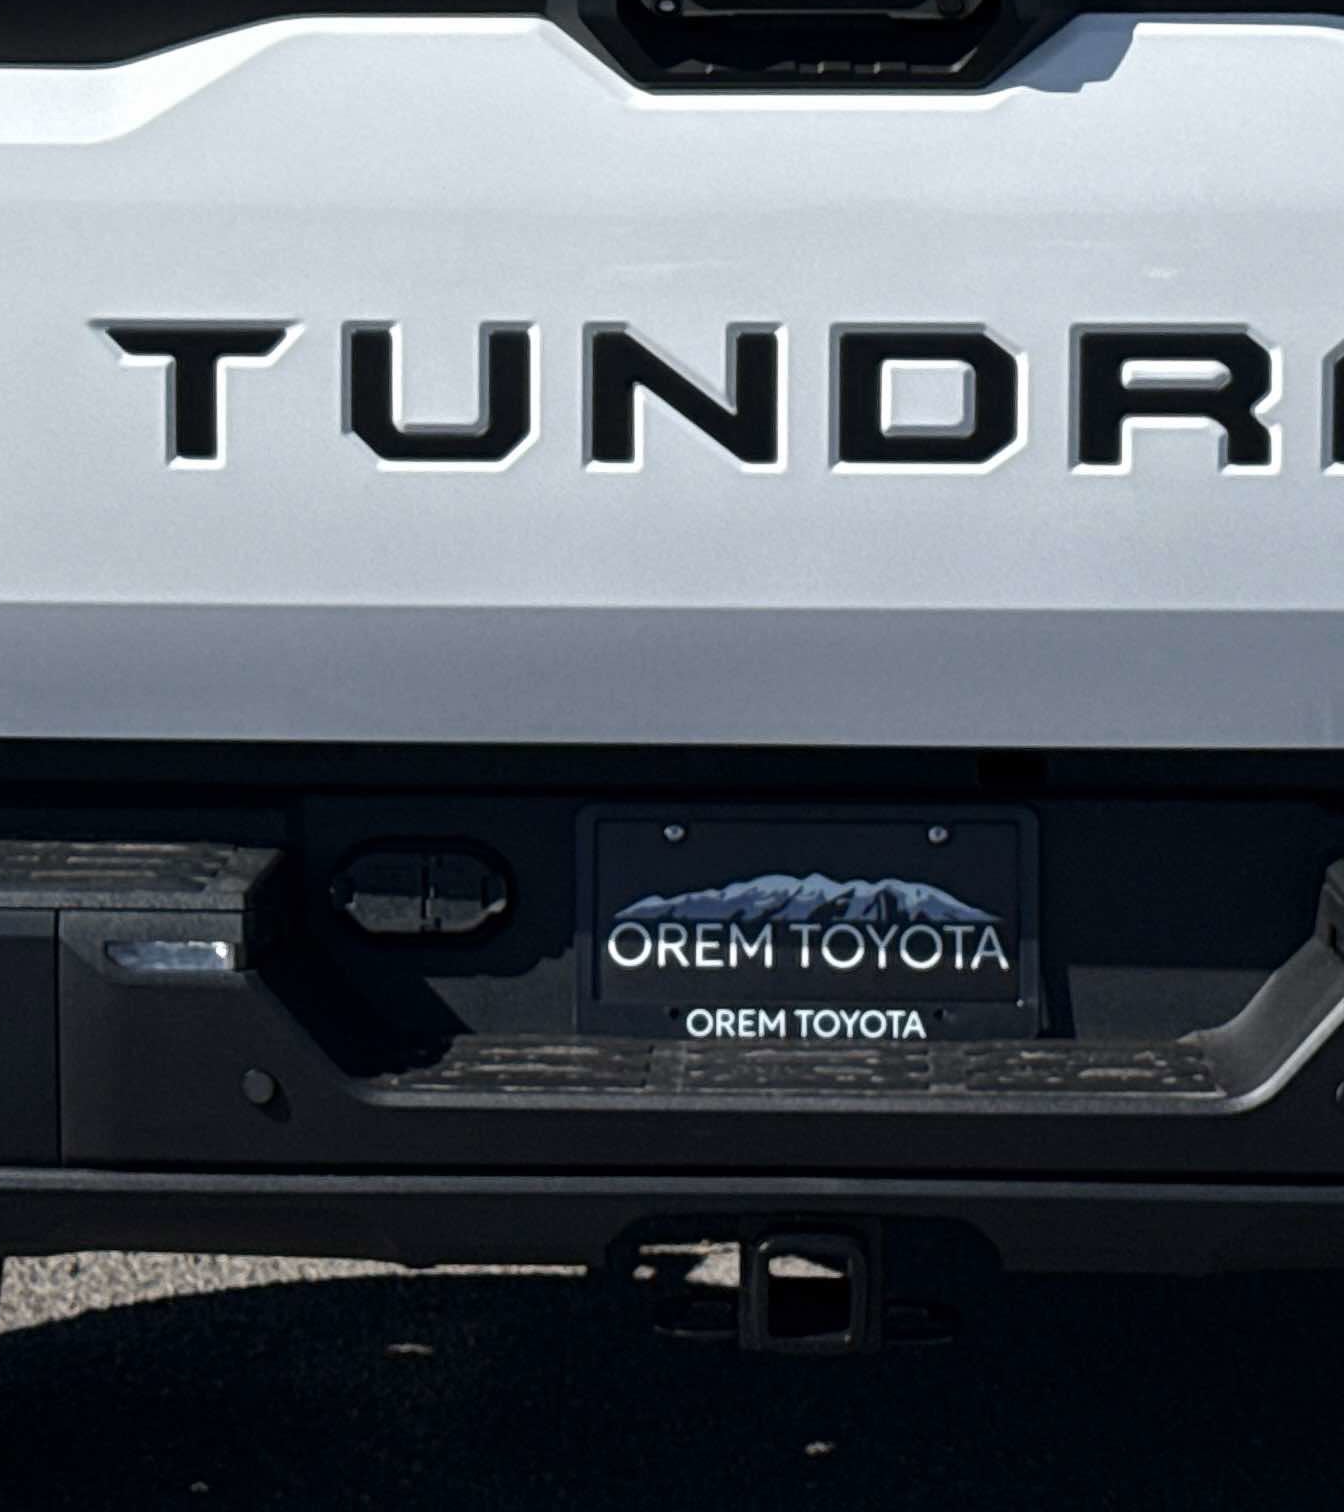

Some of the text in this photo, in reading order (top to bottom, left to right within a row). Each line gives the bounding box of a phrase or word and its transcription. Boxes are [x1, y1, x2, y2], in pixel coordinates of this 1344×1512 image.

[607, 921, 1010, 971] OREM TOYOTA
[685, 1008, 927, 1040] OREM TOYOTA
